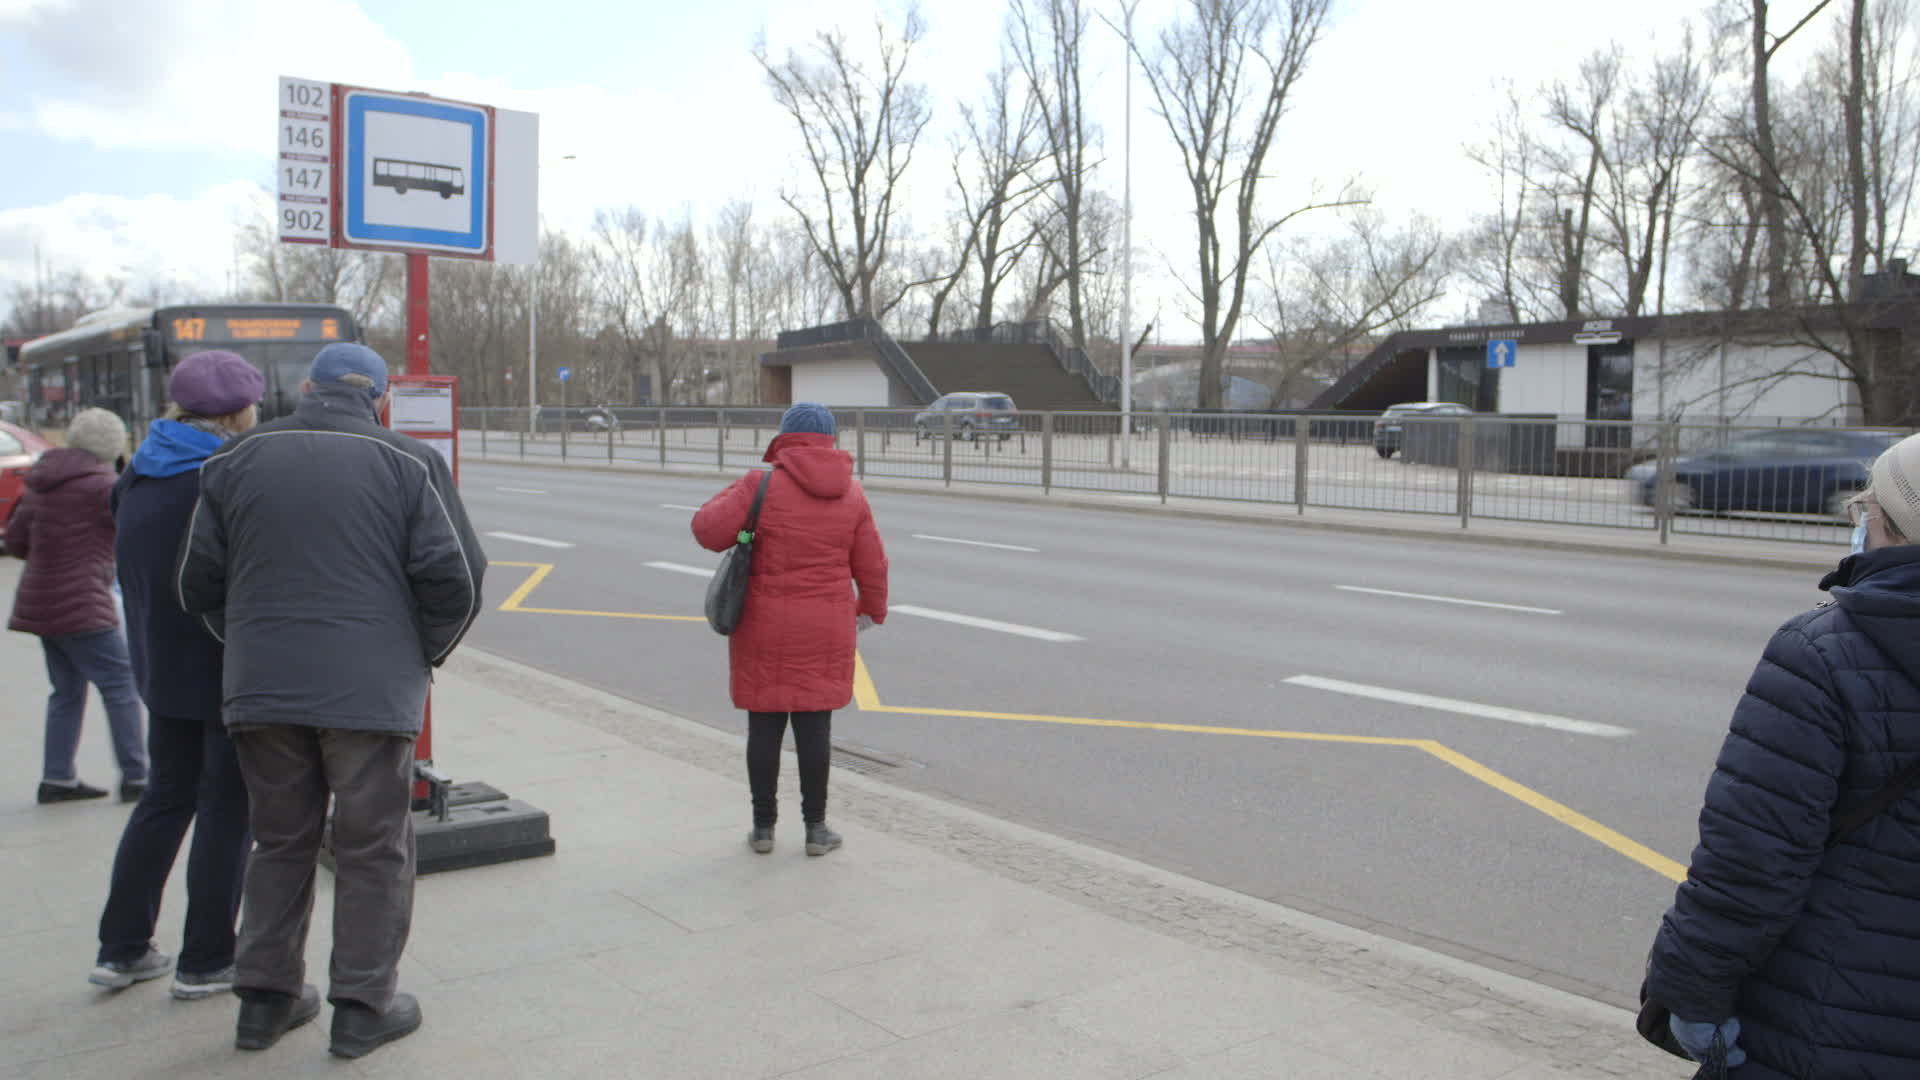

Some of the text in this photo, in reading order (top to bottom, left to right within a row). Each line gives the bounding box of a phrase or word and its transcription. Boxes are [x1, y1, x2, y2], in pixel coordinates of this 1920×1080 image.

[287, 84, 323, 107] 102
[284, 126, 324, 149] 146
[285, 168, 323, 190] 147
[283, 209, 324, 231] 902
[173, 318, 206, 340] 147
